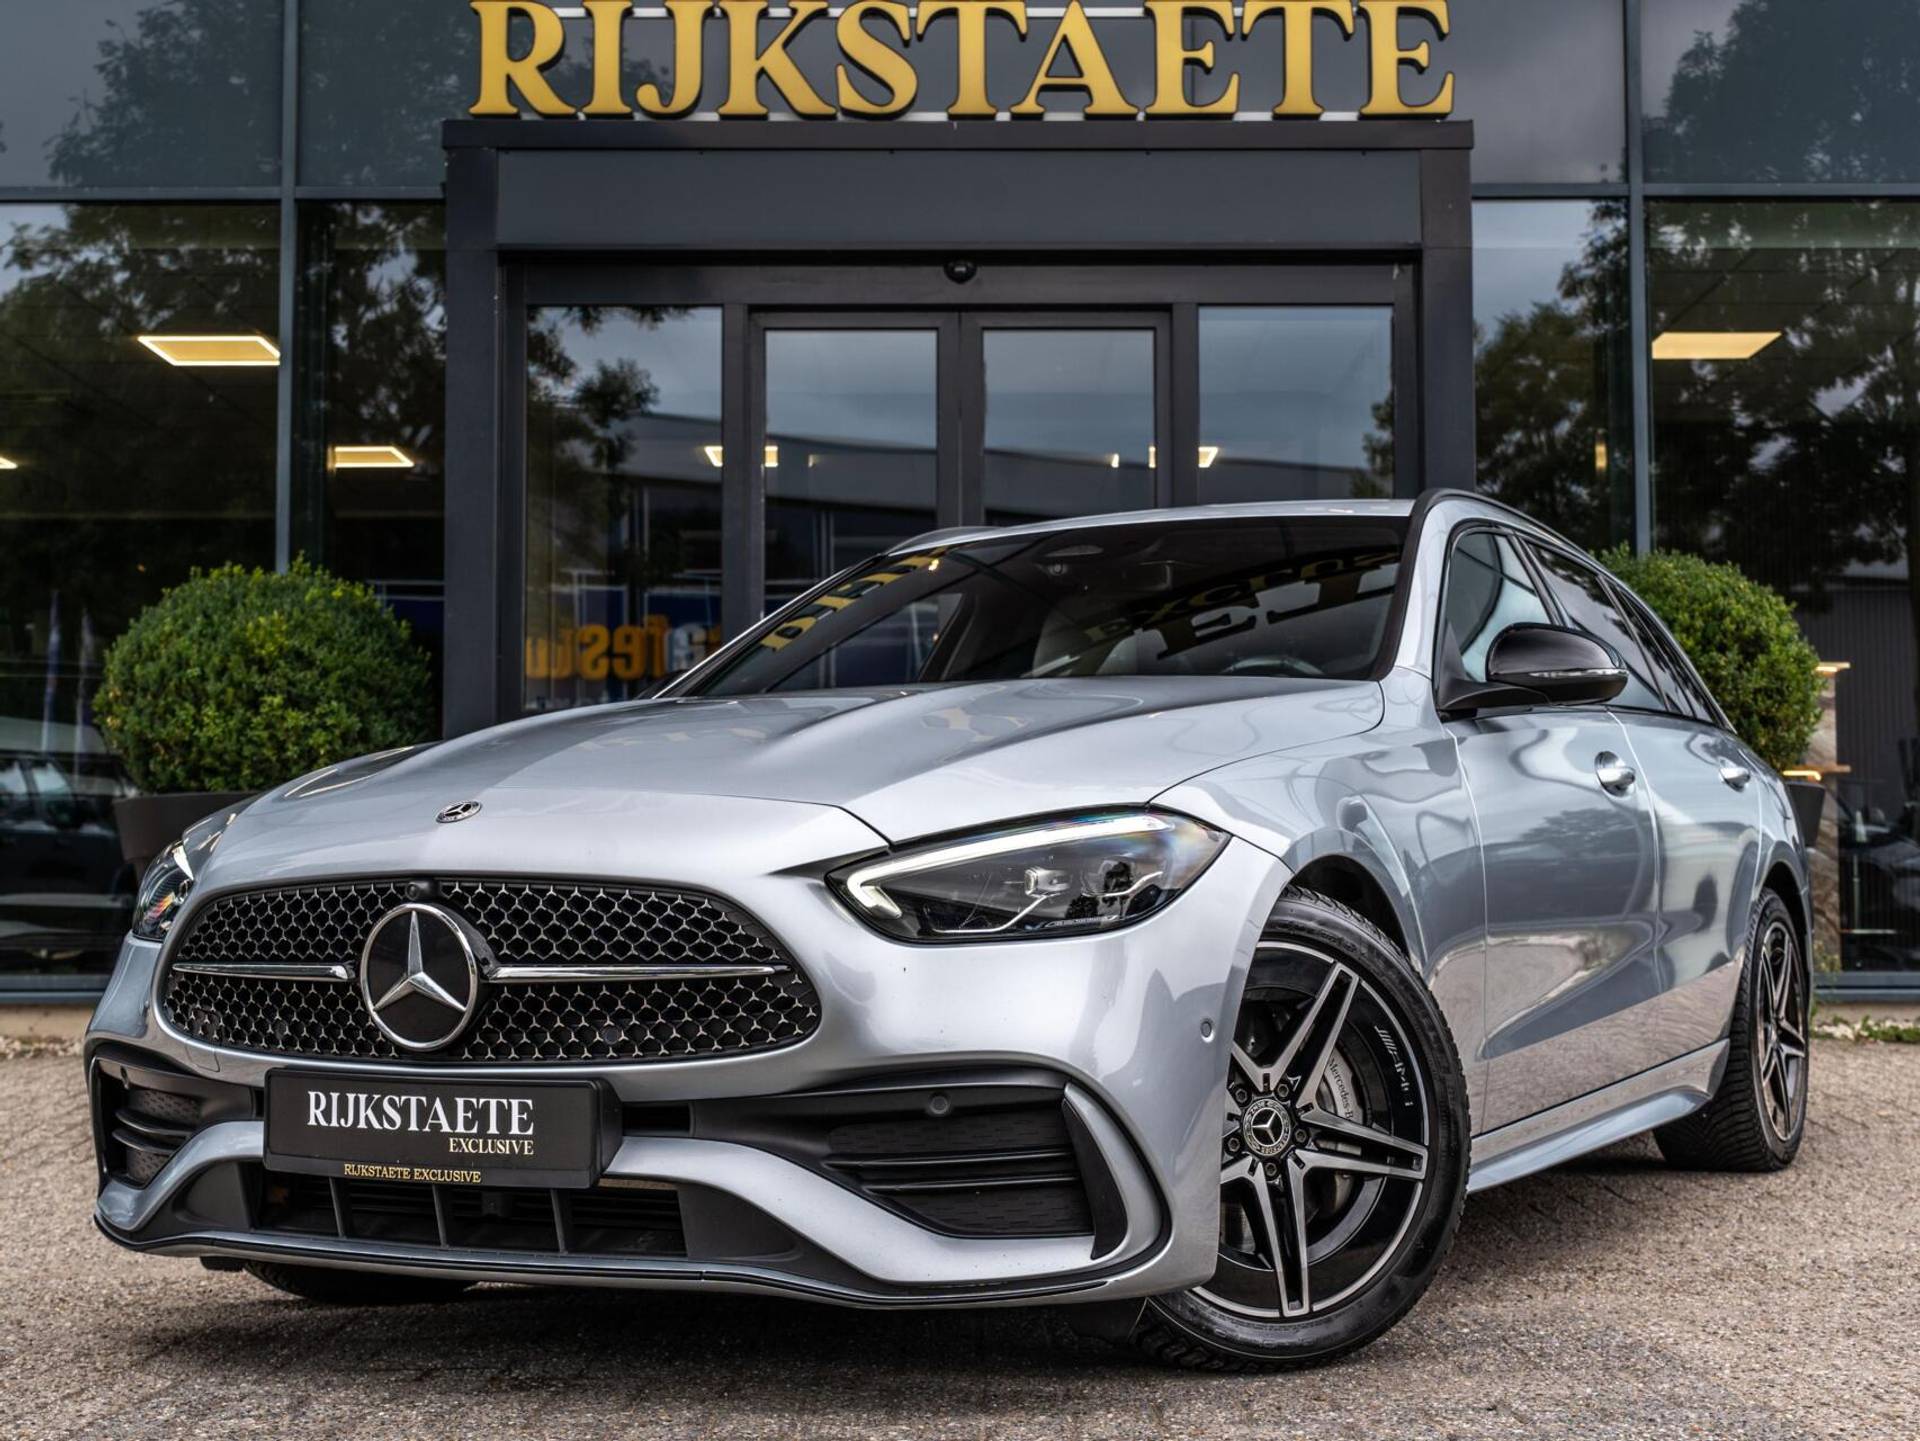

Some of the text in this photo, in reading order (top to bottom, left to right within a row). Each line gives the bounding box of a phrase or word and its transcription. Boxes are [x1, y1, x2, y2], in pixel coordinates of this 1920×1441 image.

[470, 0, 1455, 118] RIJKSTAETE
[307, 1090, 534, 1136] RIJKSTAETE
[449, 1138, 534, 1155] EXCLUSIVE
[344, 1163, 481, 1183] RIJKSTAETE EXCLUSIVE
